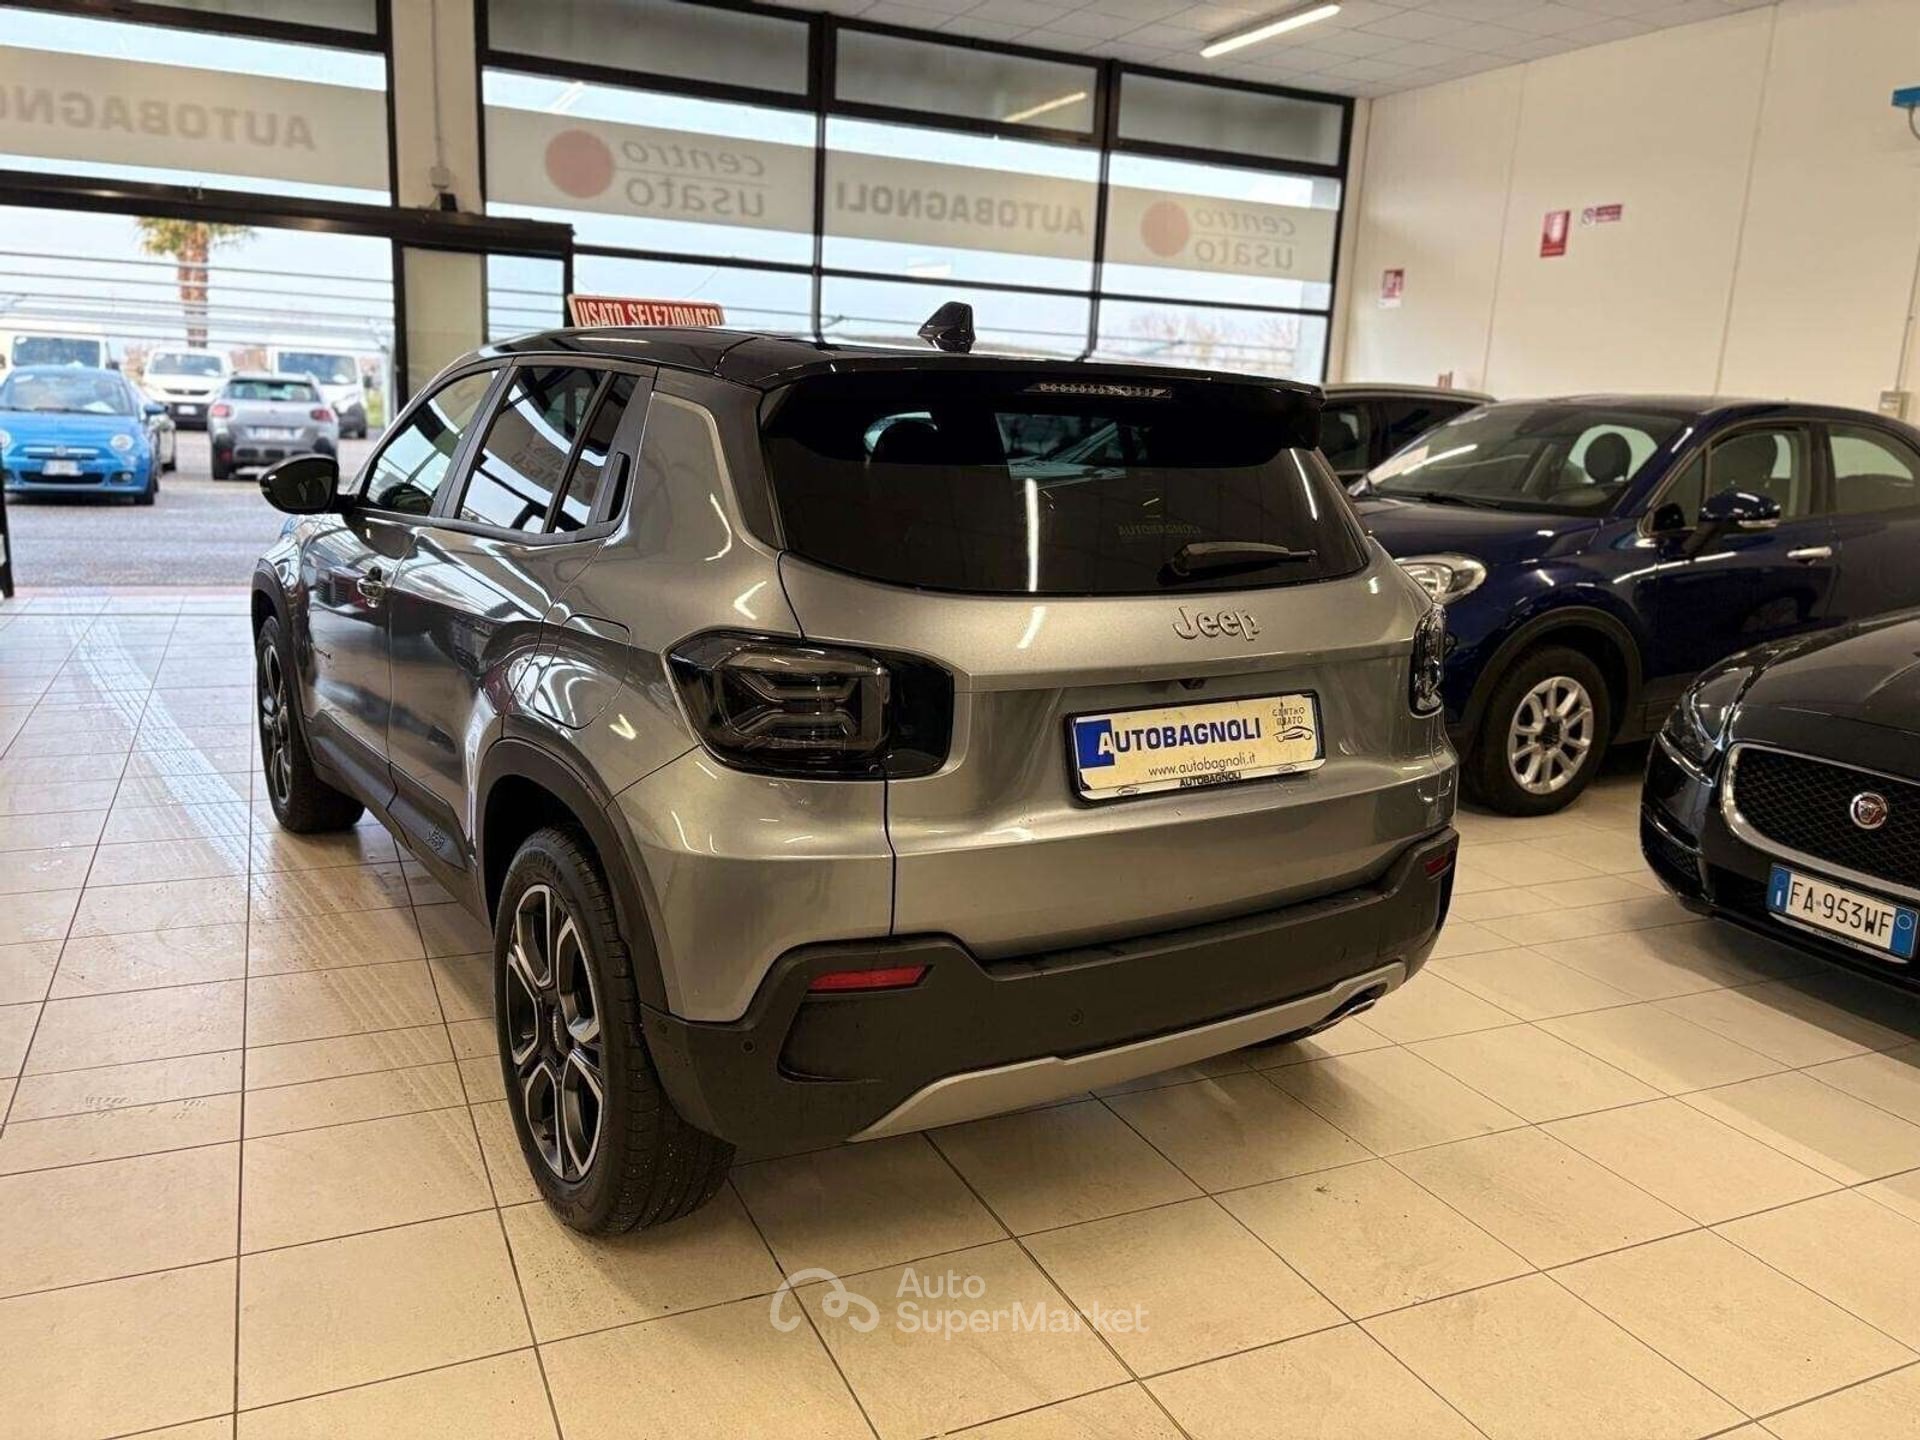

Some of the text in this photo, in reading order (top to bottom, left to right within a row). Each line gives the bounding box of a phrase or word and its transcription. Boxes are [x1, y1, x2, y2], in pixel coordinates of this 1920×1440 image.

[577, 301, 721, 327] USATO SELEZIONATO
[1172, 605, 1260, 642] Jeep
[1097, 717, 1262, 756] AUTOBAGNOLI
[1148, 752, 1257, 776] www.autobagnoli.it
[1179, 770, 1242, 787] AUTOBAGNOLI
